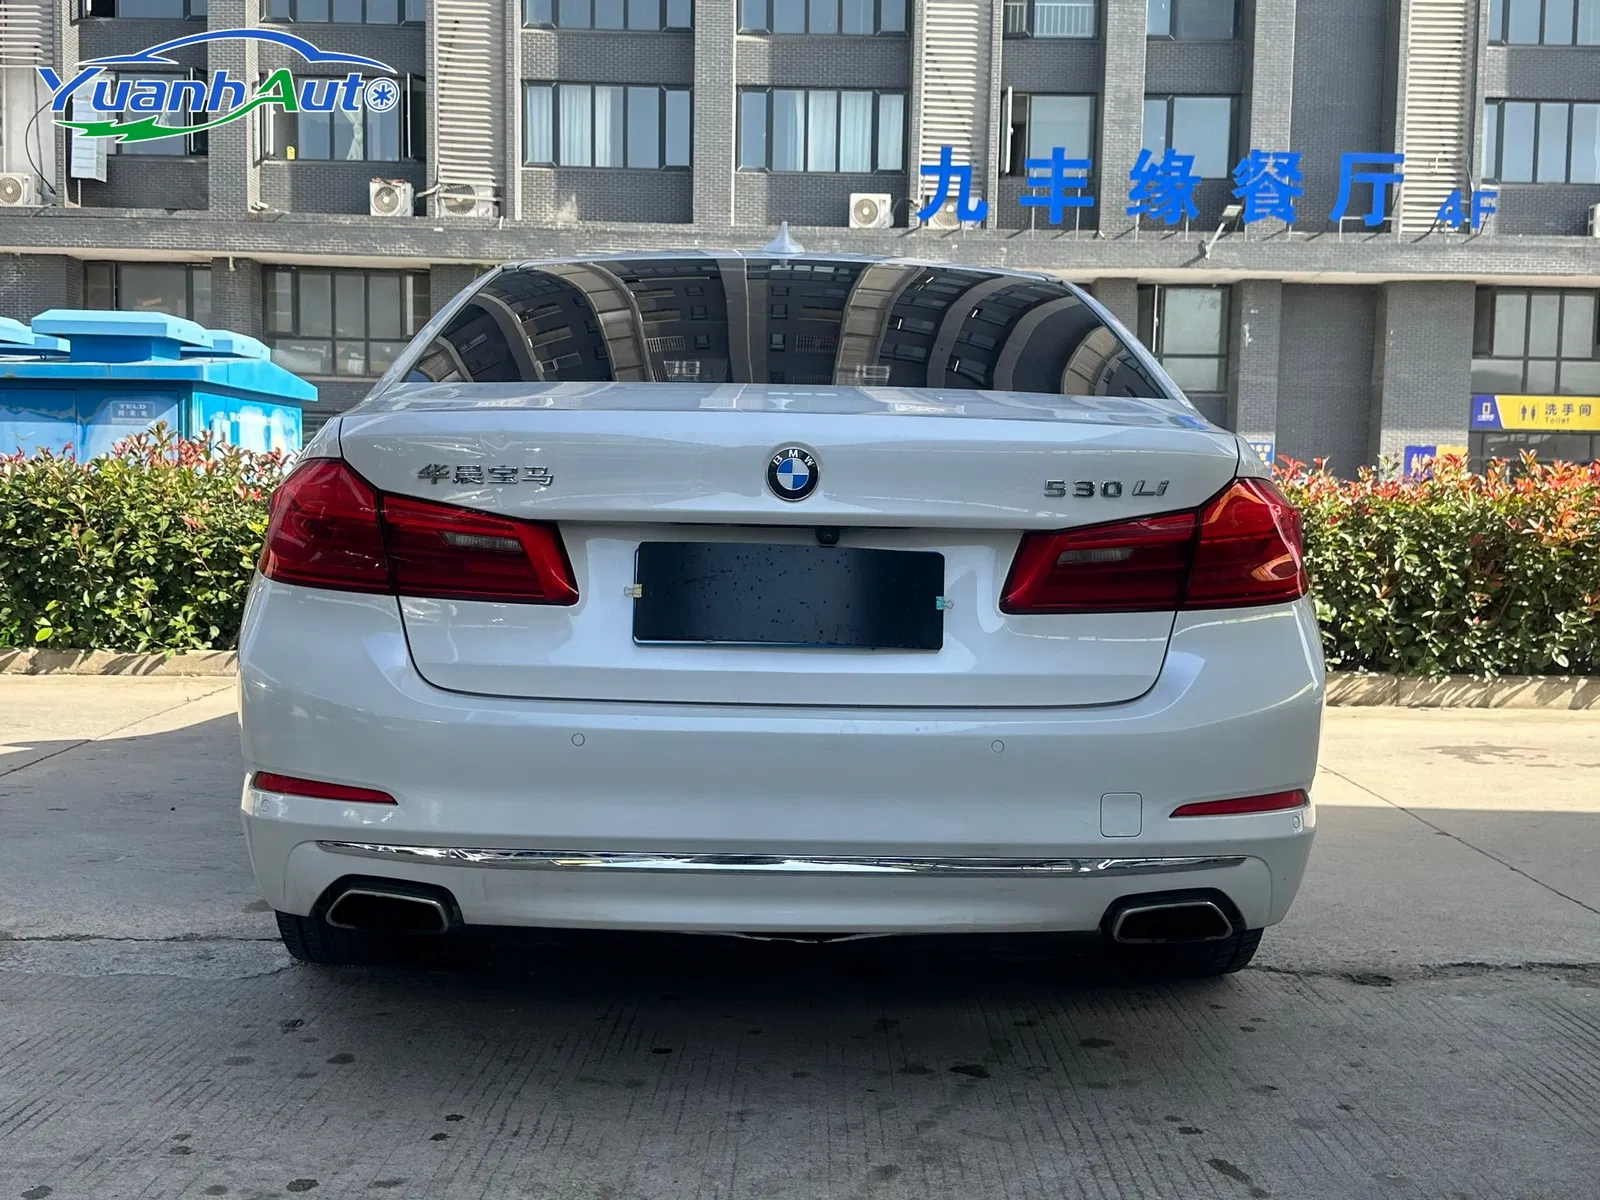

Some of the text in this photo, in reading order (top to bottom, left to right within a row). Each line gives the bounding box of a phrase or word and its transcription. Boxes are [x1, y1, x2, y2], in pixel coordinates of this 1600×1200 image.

[917, 146, 1497, 230] 九丰缘餐厅 4F
[1545, 403, 1592, 416] 洗手间
[1545, 416, 1570, 424] Toilet
[773, 449, 815, 467] BMW
[417, 463, 554, 486] 华晨宝马
